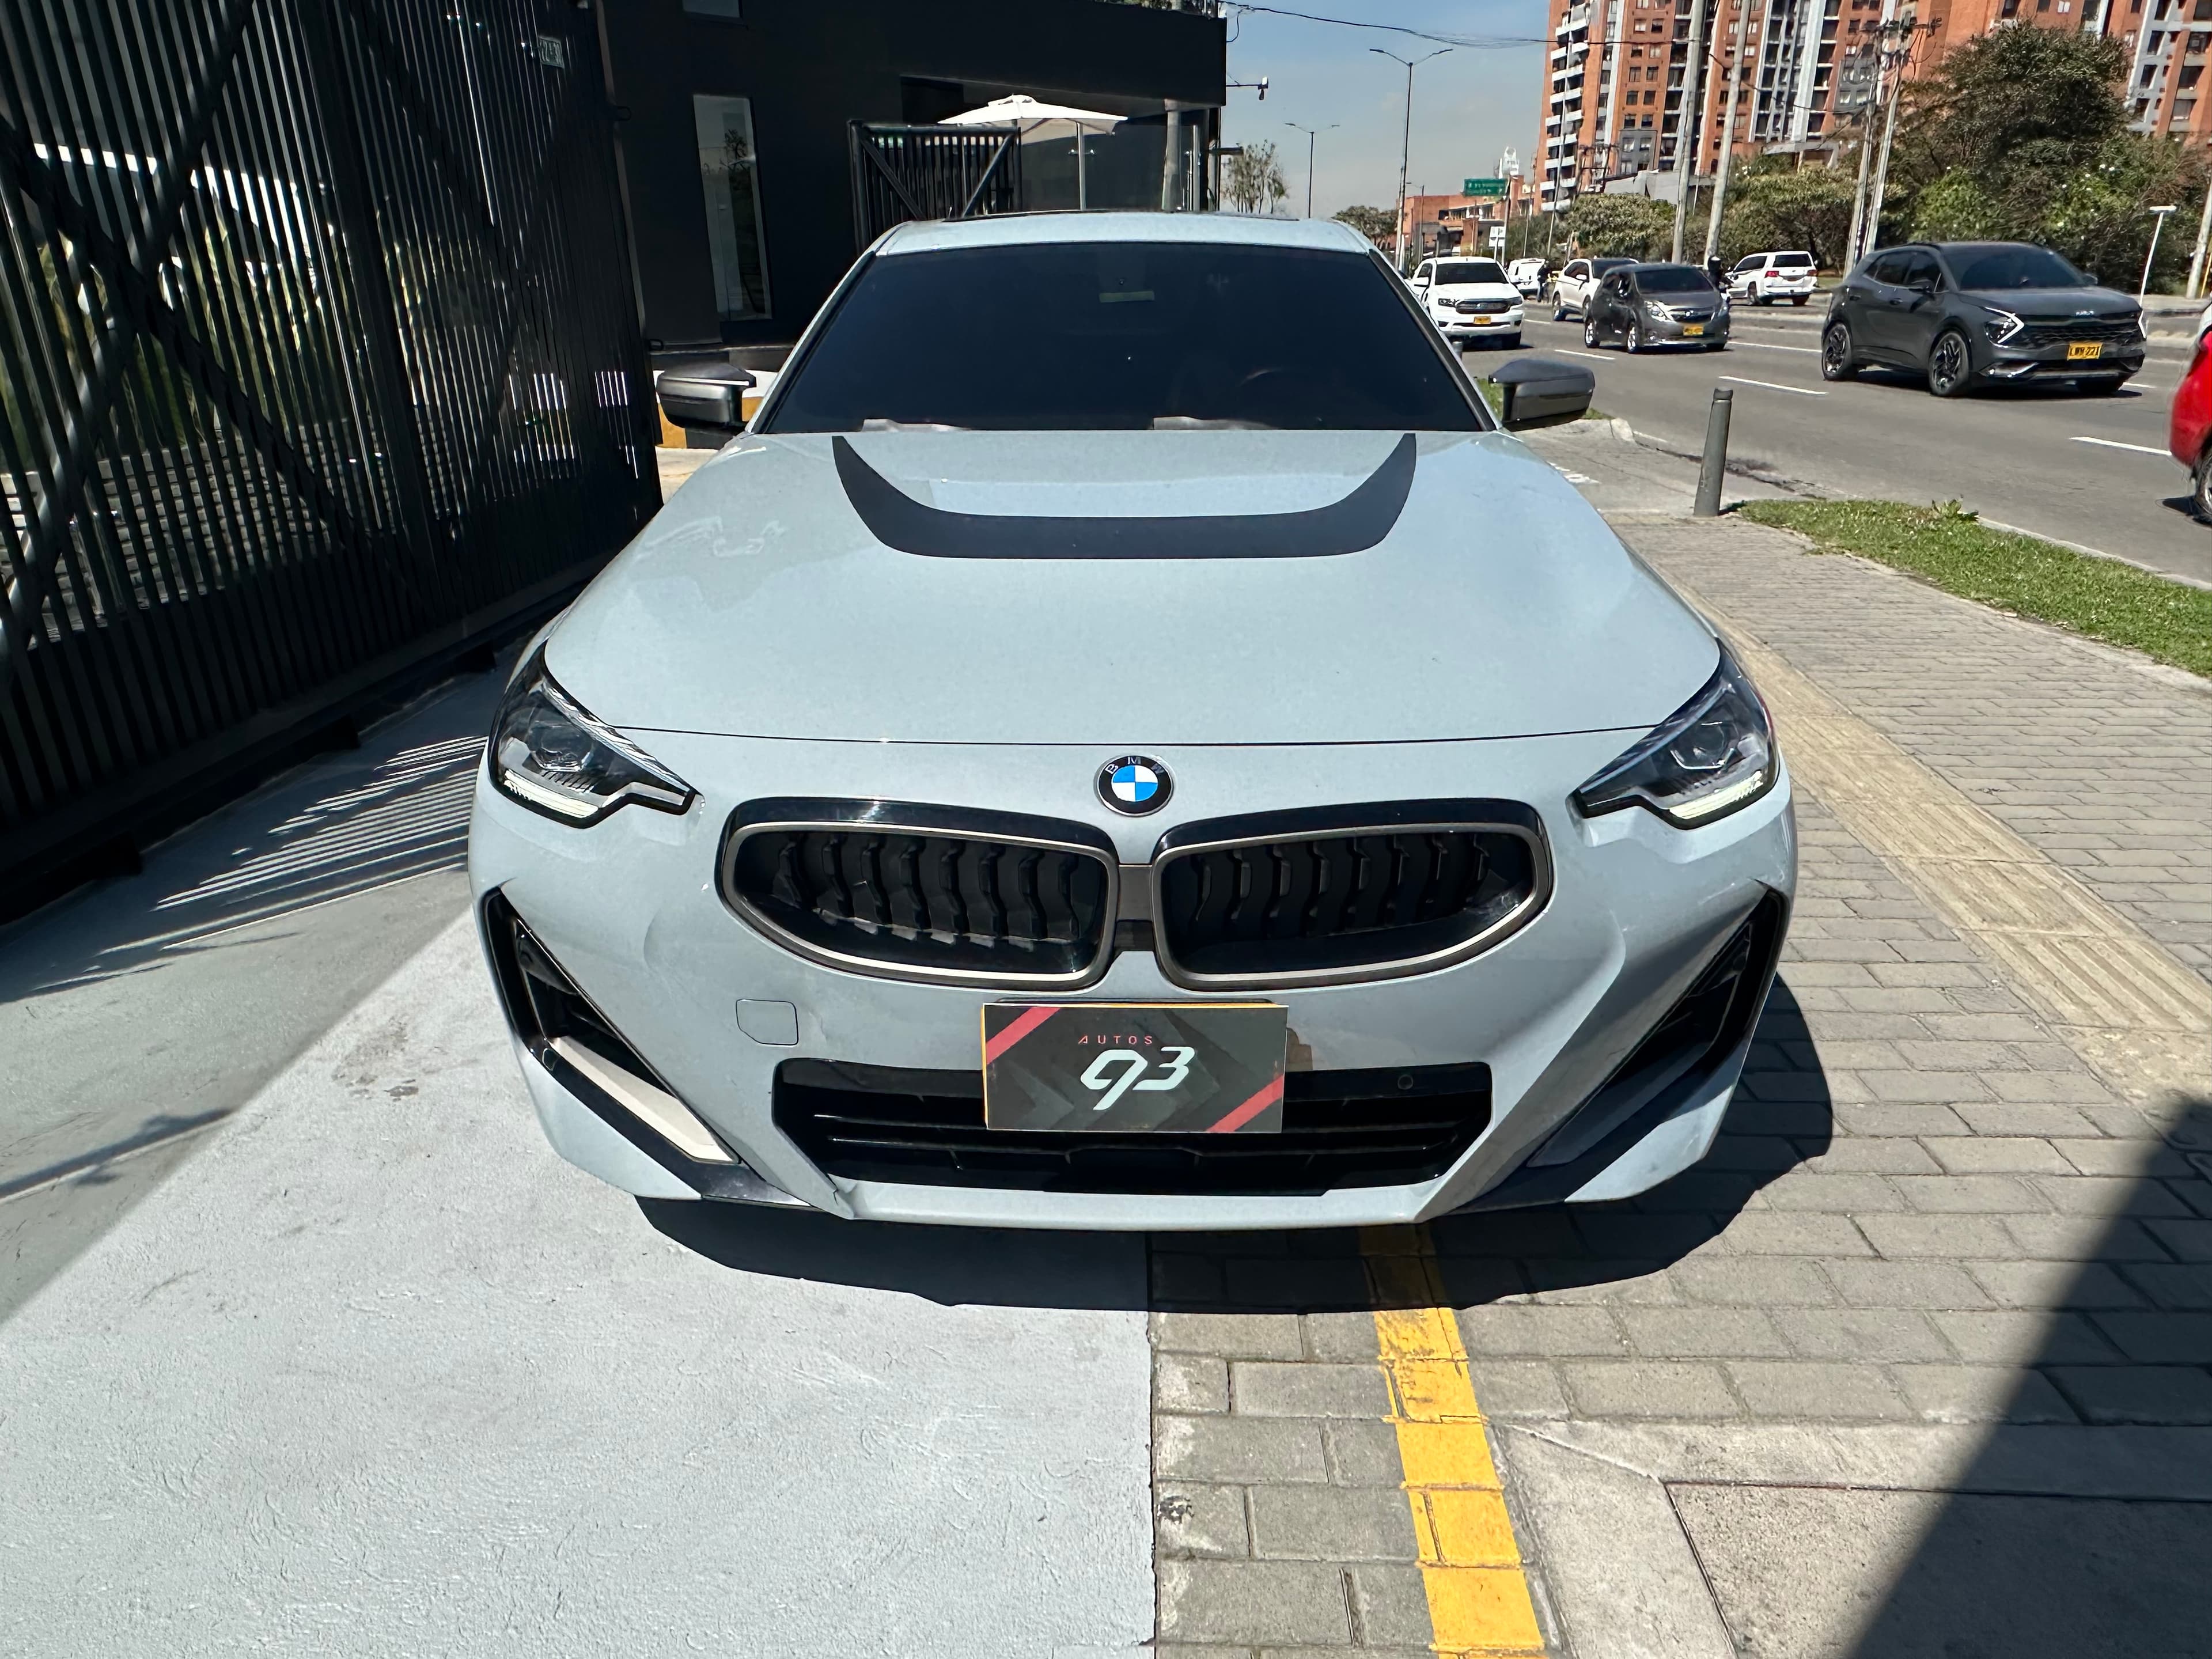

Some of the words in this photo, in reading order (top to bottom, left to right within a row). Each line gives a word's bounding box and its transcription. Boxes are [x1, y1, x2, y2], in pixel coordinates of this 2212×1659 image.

[1105, 756, 1164, 774] BMW
[1078, 1035, 1153, 1045] AUTOS
[1080, 1046, 1195, 1111] 93
